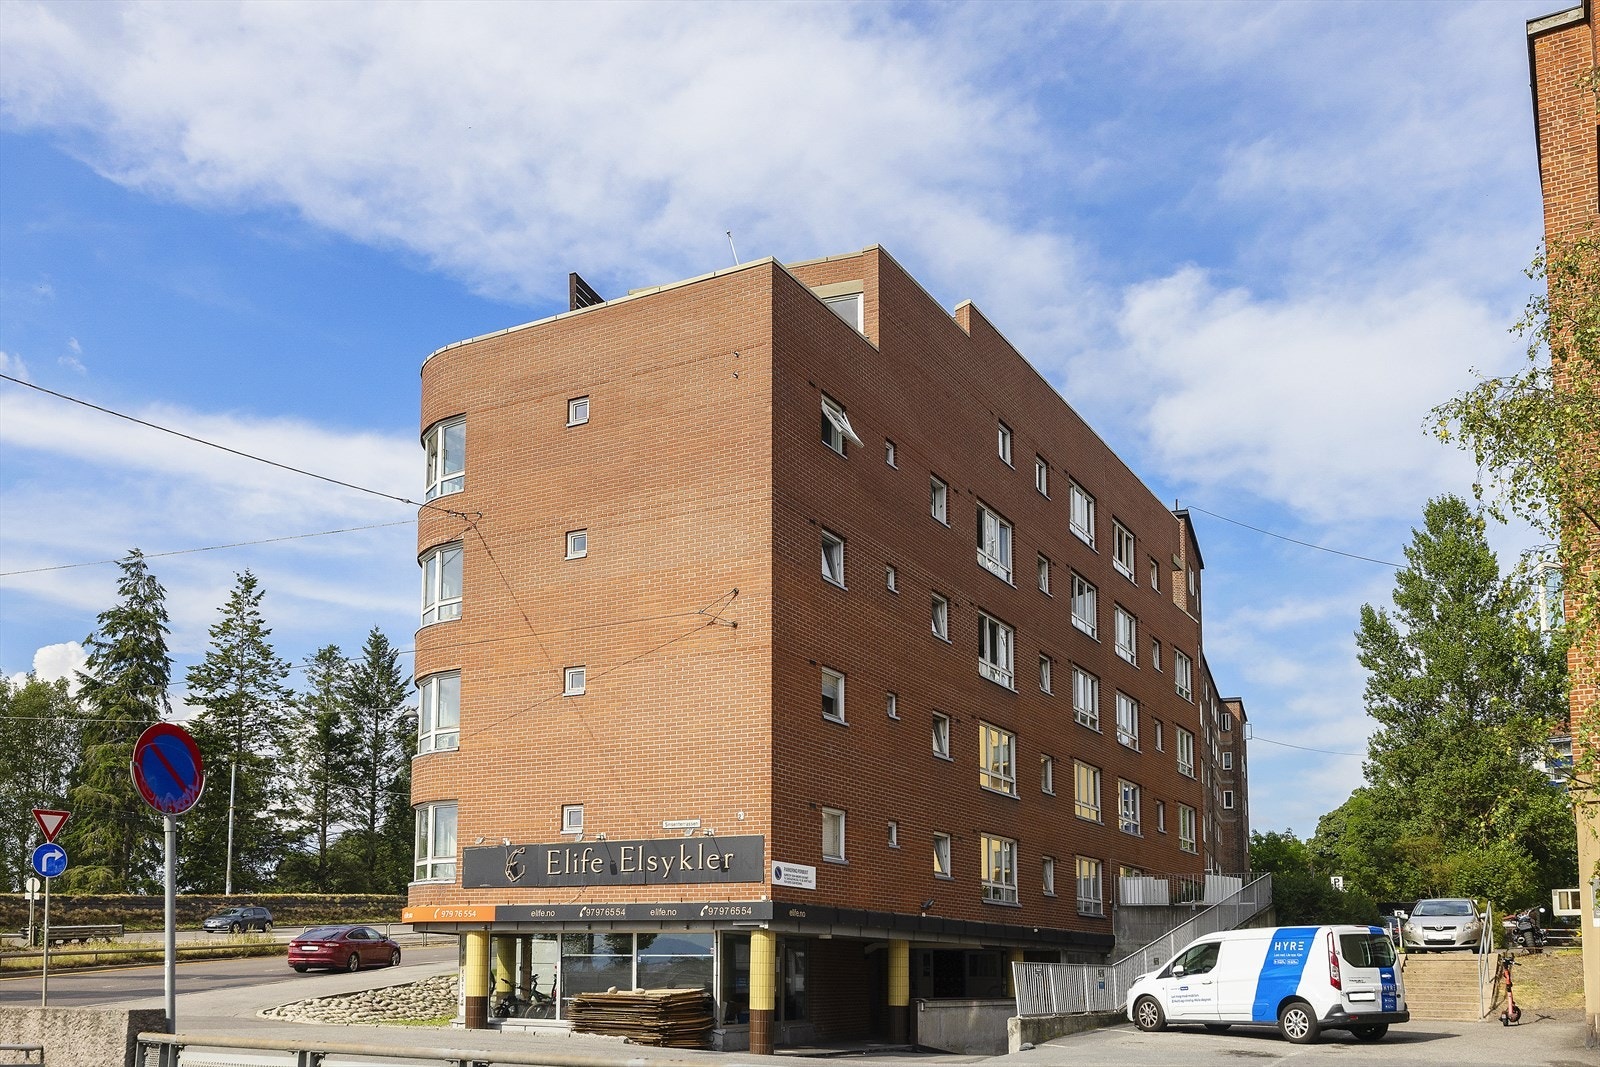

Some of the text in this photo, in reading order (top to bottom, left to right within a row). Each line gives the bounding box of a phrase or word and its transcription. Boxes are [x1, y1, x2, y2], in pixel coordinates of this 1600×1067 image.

[547, 842, 734, 878] Elife Elsykler
[530, 909, 556, 918] elife.no
[650, 908, 677, 916] elife.no
[1274, 941, 1305, 951] HYRE
